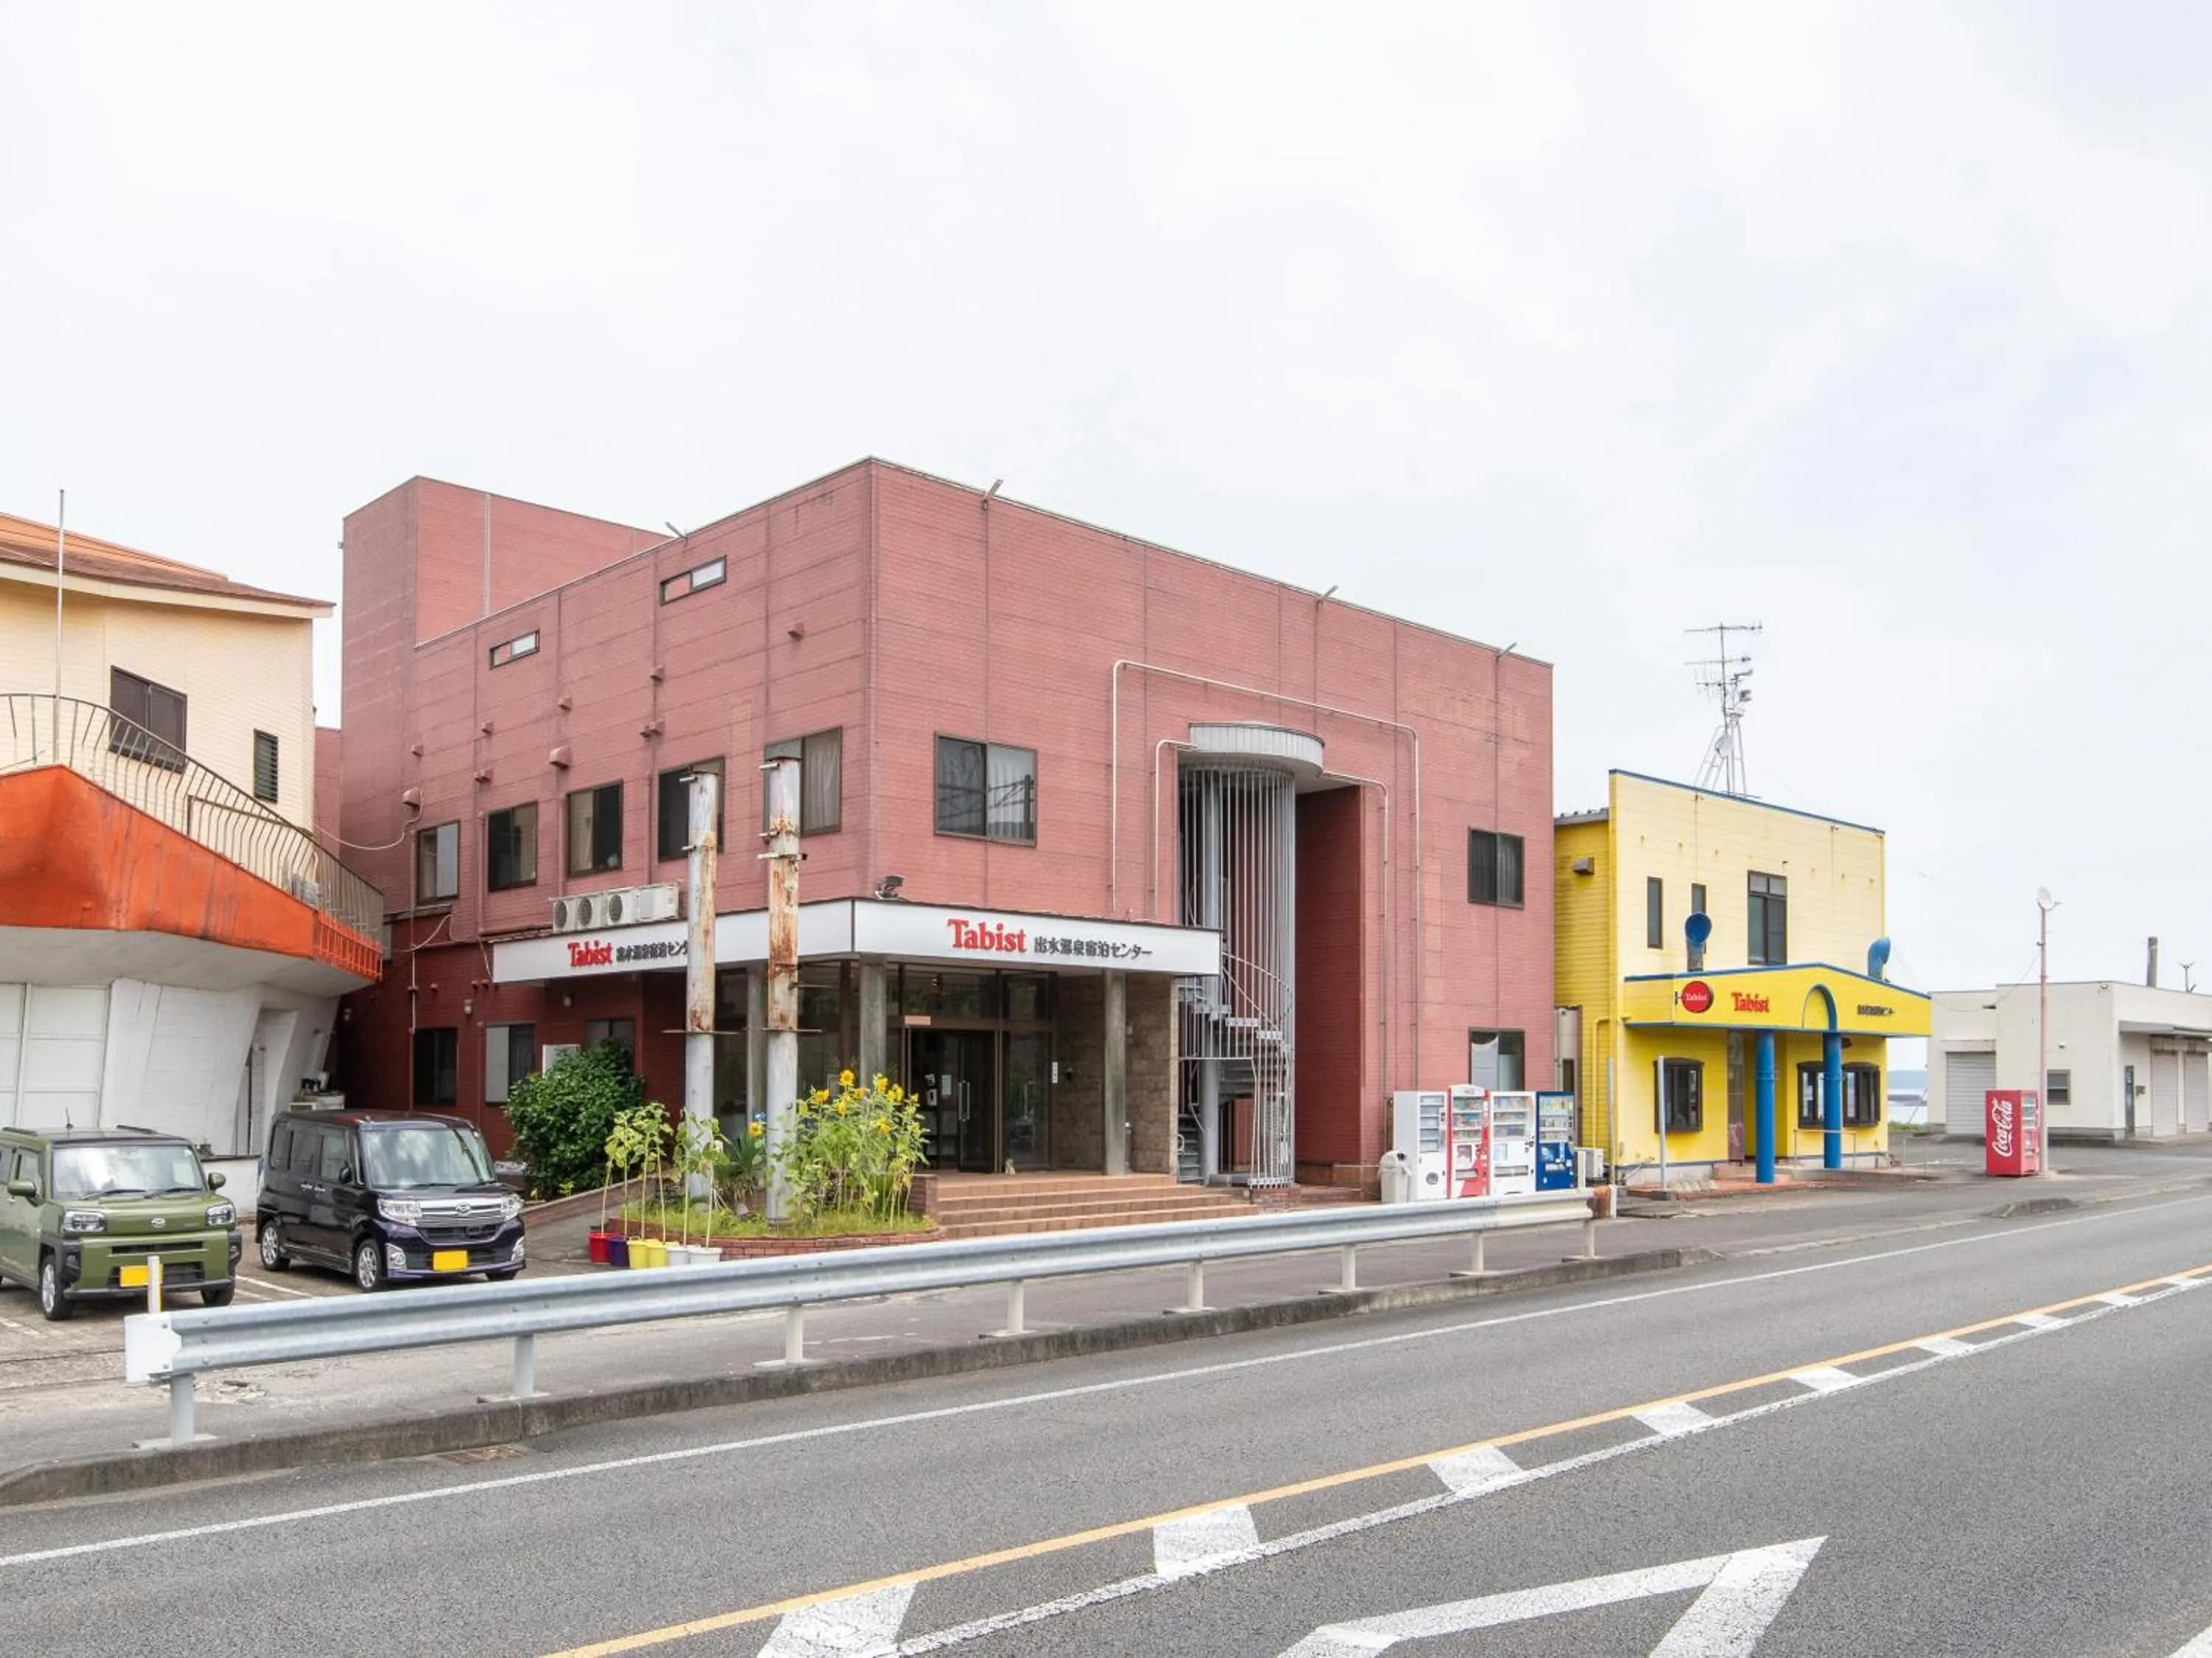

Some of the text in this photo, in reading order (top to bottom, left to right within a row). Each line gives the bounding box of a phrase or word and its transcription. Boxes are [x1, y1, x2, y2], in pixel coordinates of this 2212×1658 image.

[947, 918, 1152, 960] Tabist 出水温泉宿泊センター
[567, 940, 613, 967] Tabist
[1731, 991, 1770, 1013] Tabist
